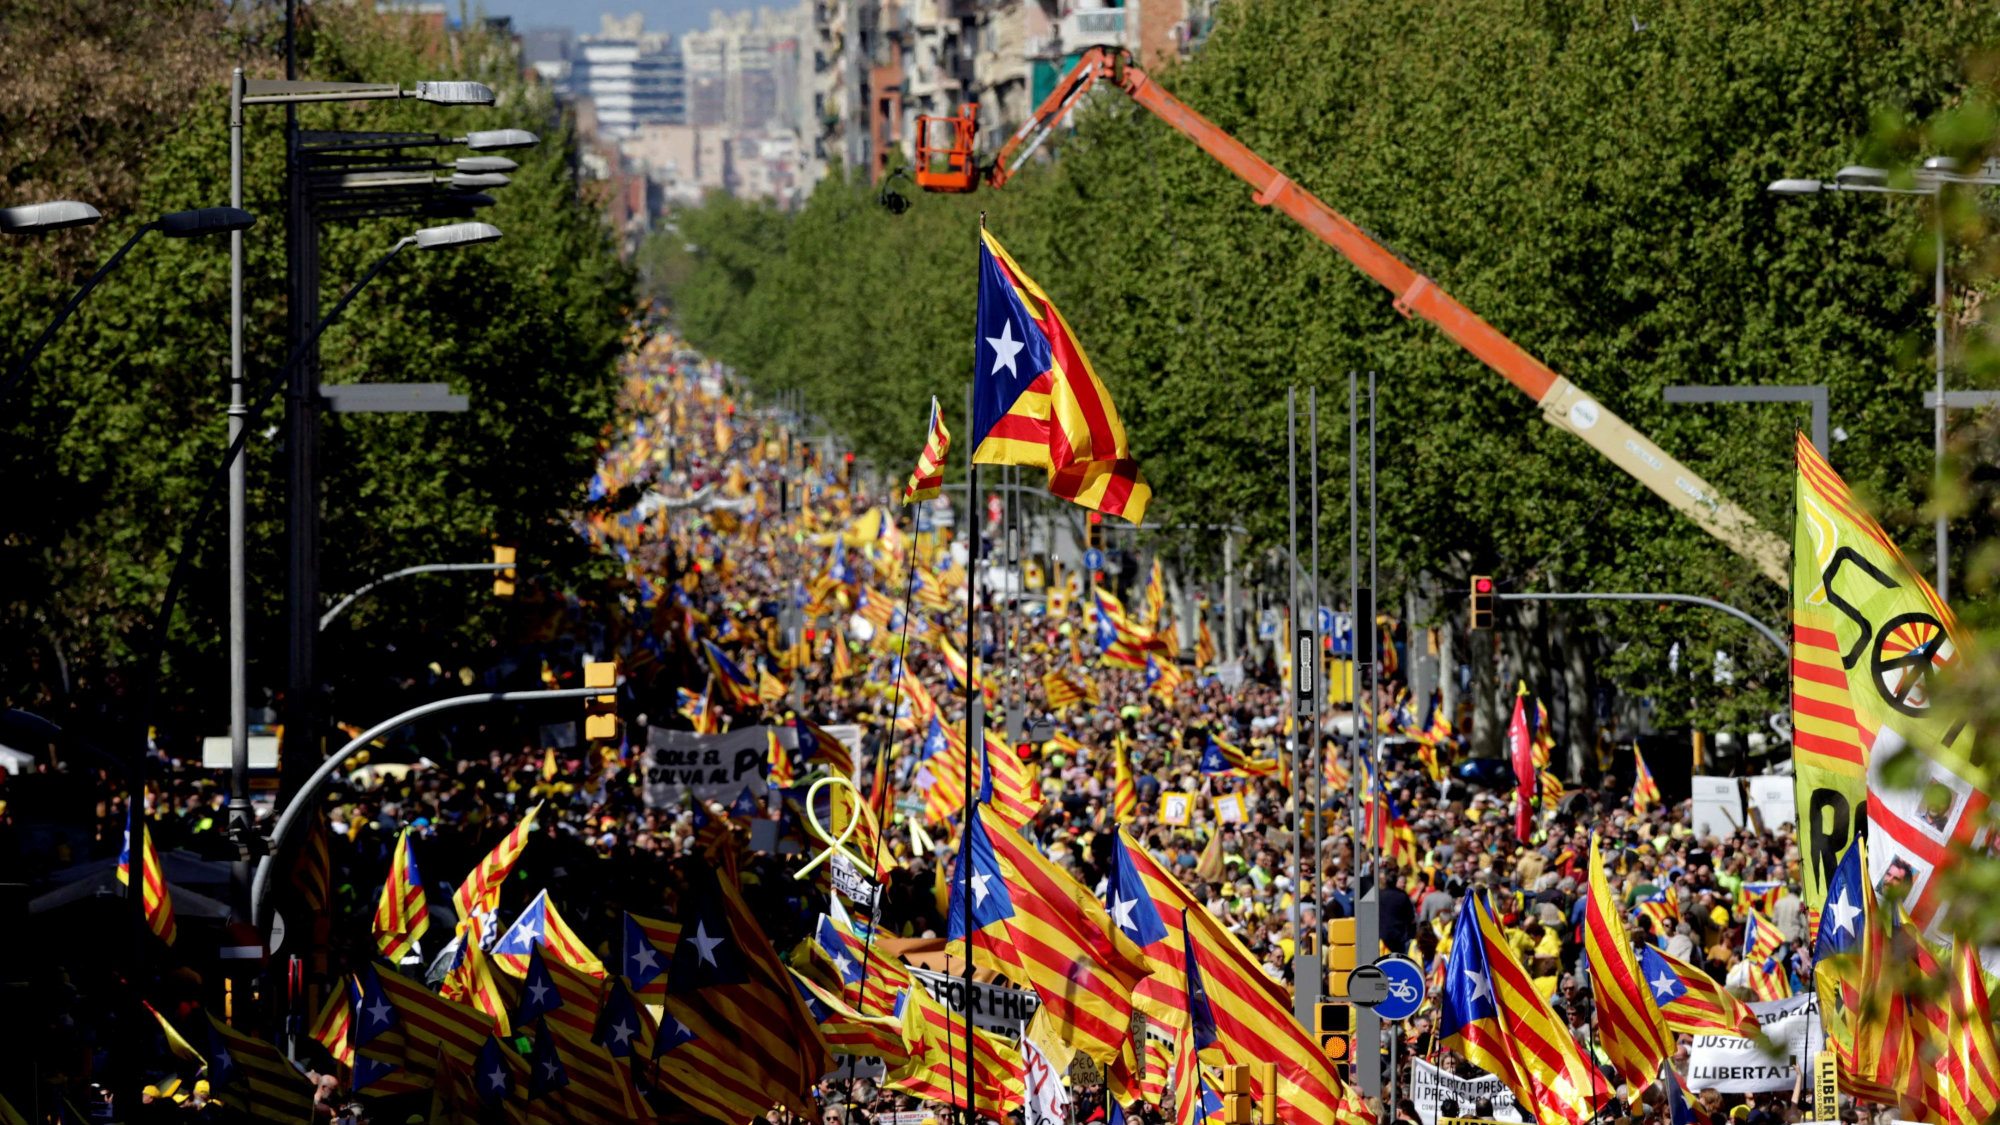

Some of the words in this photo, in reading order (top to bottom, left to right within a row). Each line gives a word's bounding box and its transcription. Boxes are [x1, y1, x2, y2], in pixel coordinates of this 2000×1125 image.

[656, 749, 699, 766] SOLS
[648, 767, 703, 785] SALVA
[934, 979, 983, 1014] FOR
[1757, 1002, 1819, 1026] CRÀCIA
[1697, 1035, 1758, 1050] JUSTIC
[1072, 1057, 1094, 1069] PEO
[1072, 1071, 1104, 1084] EUROP
[1693, 1065, 1791, 1080] LLIBERTAT
[1417, 1071, 1474, 1093] LLIBERTAT
[1417, 1087, 1421, 1099] I
[1424, 1087, 1465, 1104] PRESOS
[1469, 1093, 1516, 1107] POTICS
[1822, 1062, 1836, 1122] LLIBERT
